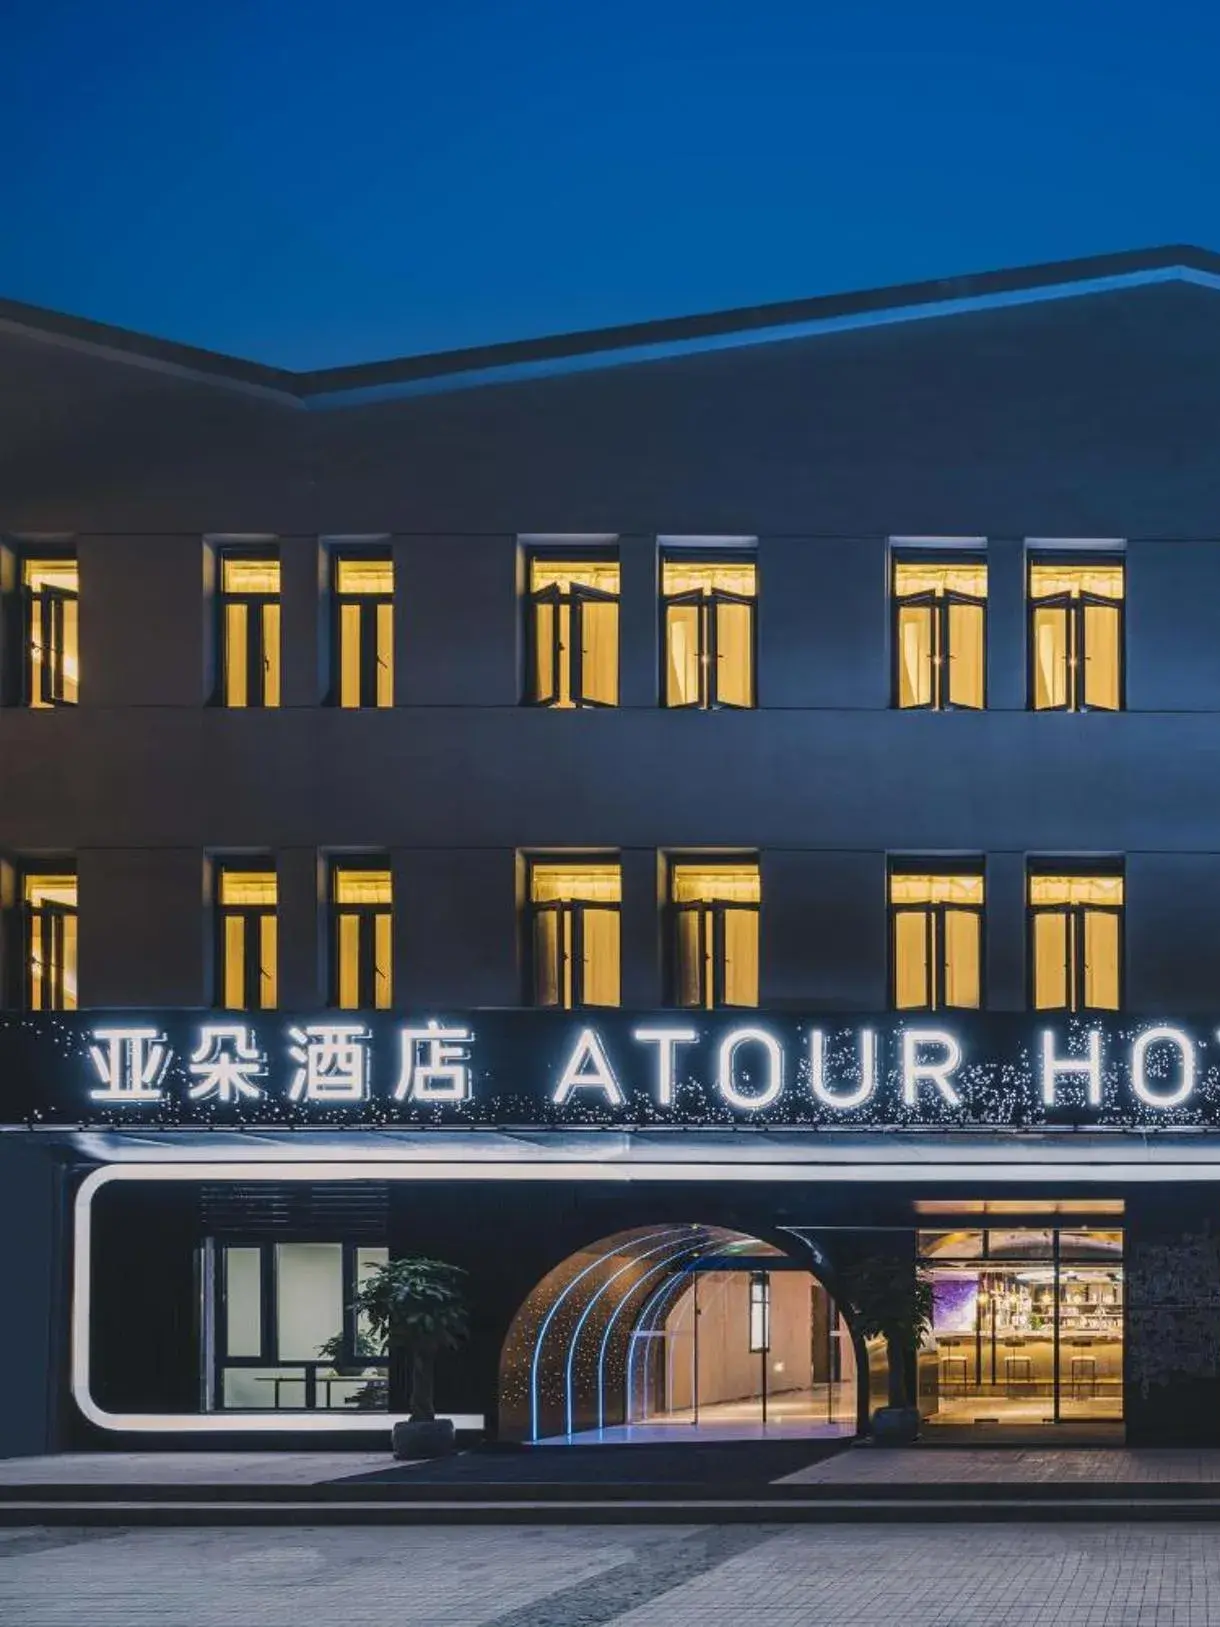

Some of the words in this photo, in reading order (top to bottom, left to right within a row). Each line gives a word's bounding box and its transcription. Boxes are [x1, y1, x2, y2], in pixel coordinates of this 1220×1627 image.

[89, 1023, 470, 1102] 亚朵酒店
[552, 1028, 963, 1110] ATOUR
